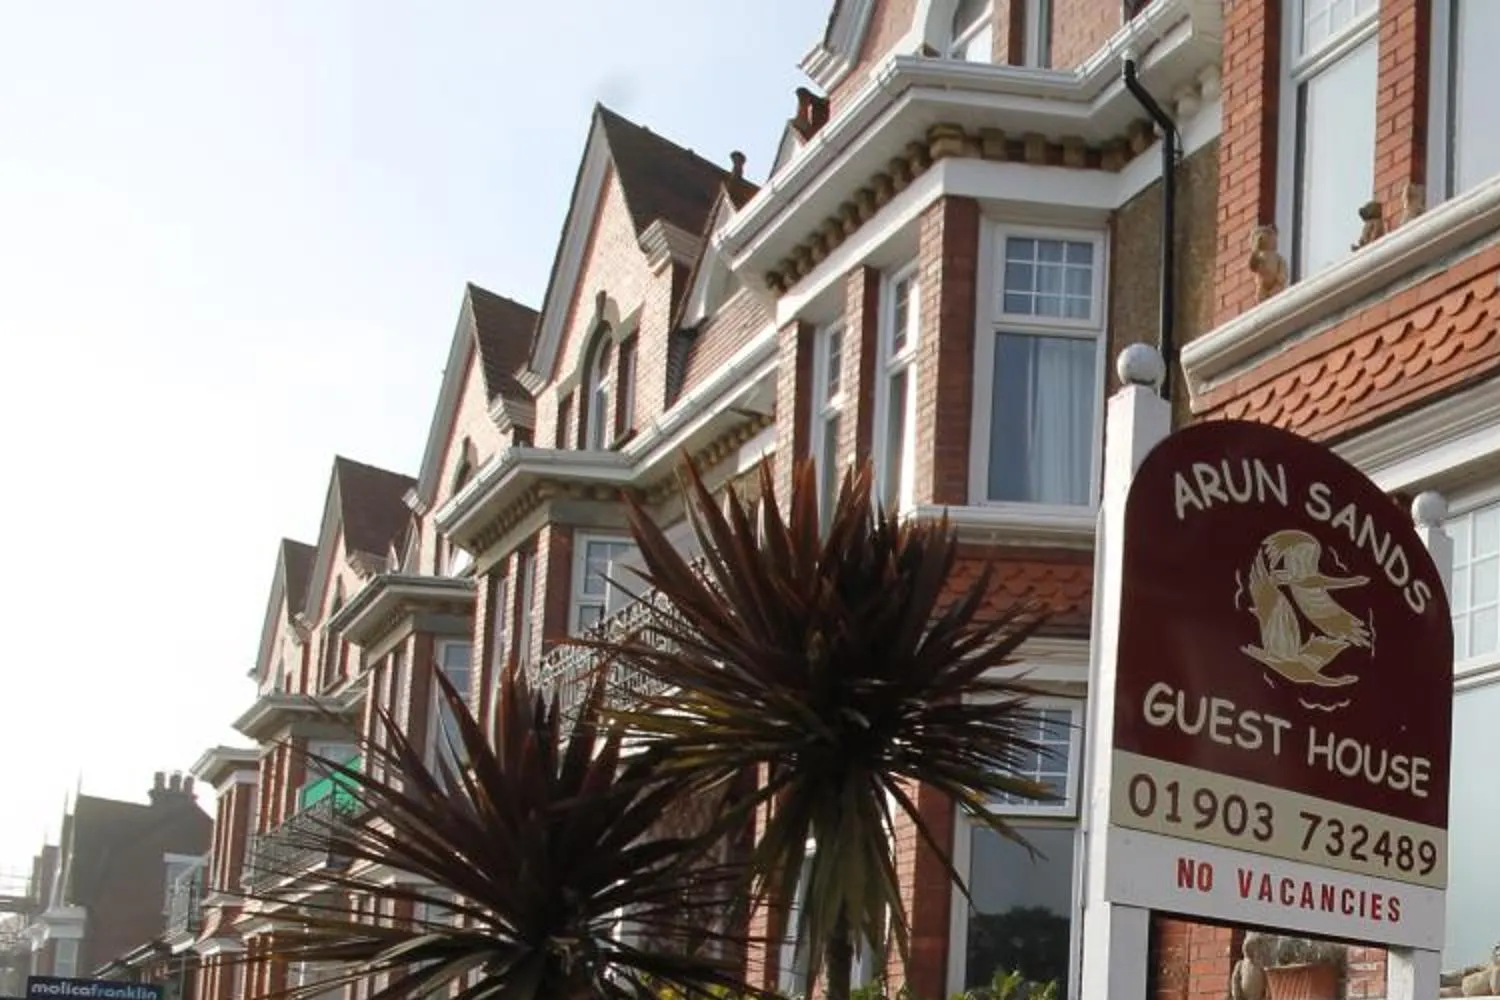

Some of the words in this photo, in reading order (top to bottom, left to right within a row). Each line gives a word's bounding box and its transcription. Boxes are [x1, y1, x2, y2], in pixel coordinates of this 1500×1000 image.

[1174, 458, 1288, 520] ARUN
[1305, 482, 1432, 615] SANDS
[1142, 682, 1291, 756] GUEST
[1308, 727, 1431, 798] HOUSE
[1128, 773, 1274, 841] 01903
[1299, 811, 1438, 876] 732489
[1177, 857, 1213, 893] NO
[1237, 868, 1402, 923] VACANCIES
[31, 982, 157, 1000] molicafranklin
